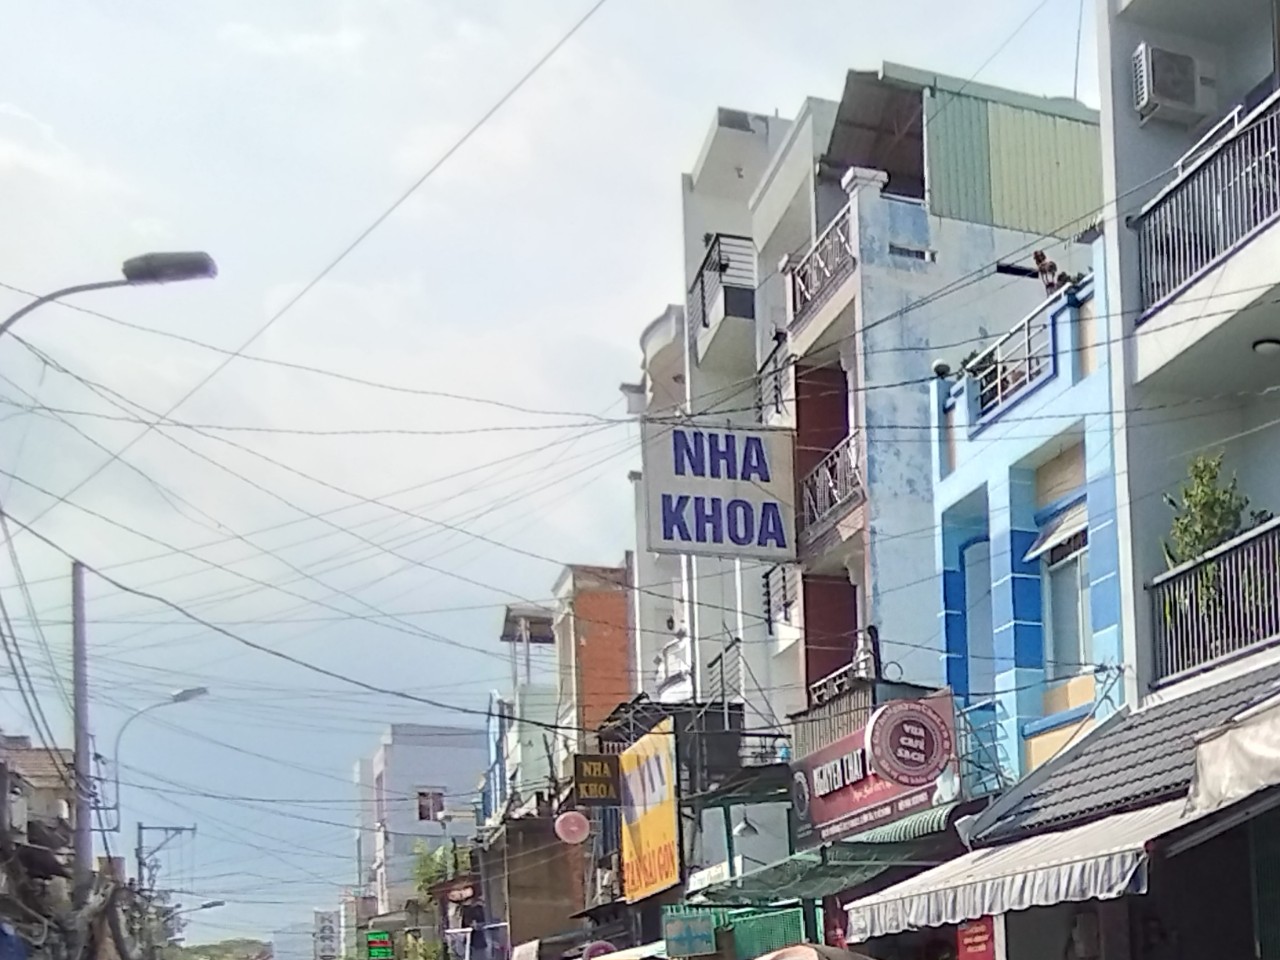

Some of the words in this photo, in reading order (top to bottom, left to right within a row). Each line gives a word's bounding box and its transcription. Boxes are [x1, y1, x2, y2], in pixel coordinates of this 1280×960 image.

[673, 429, 770, 482] NHA
[661, 494, 787, 548] KHOA
[582, 761, 611, 777] NHA
[579, 783, 616, 799] KHOA
